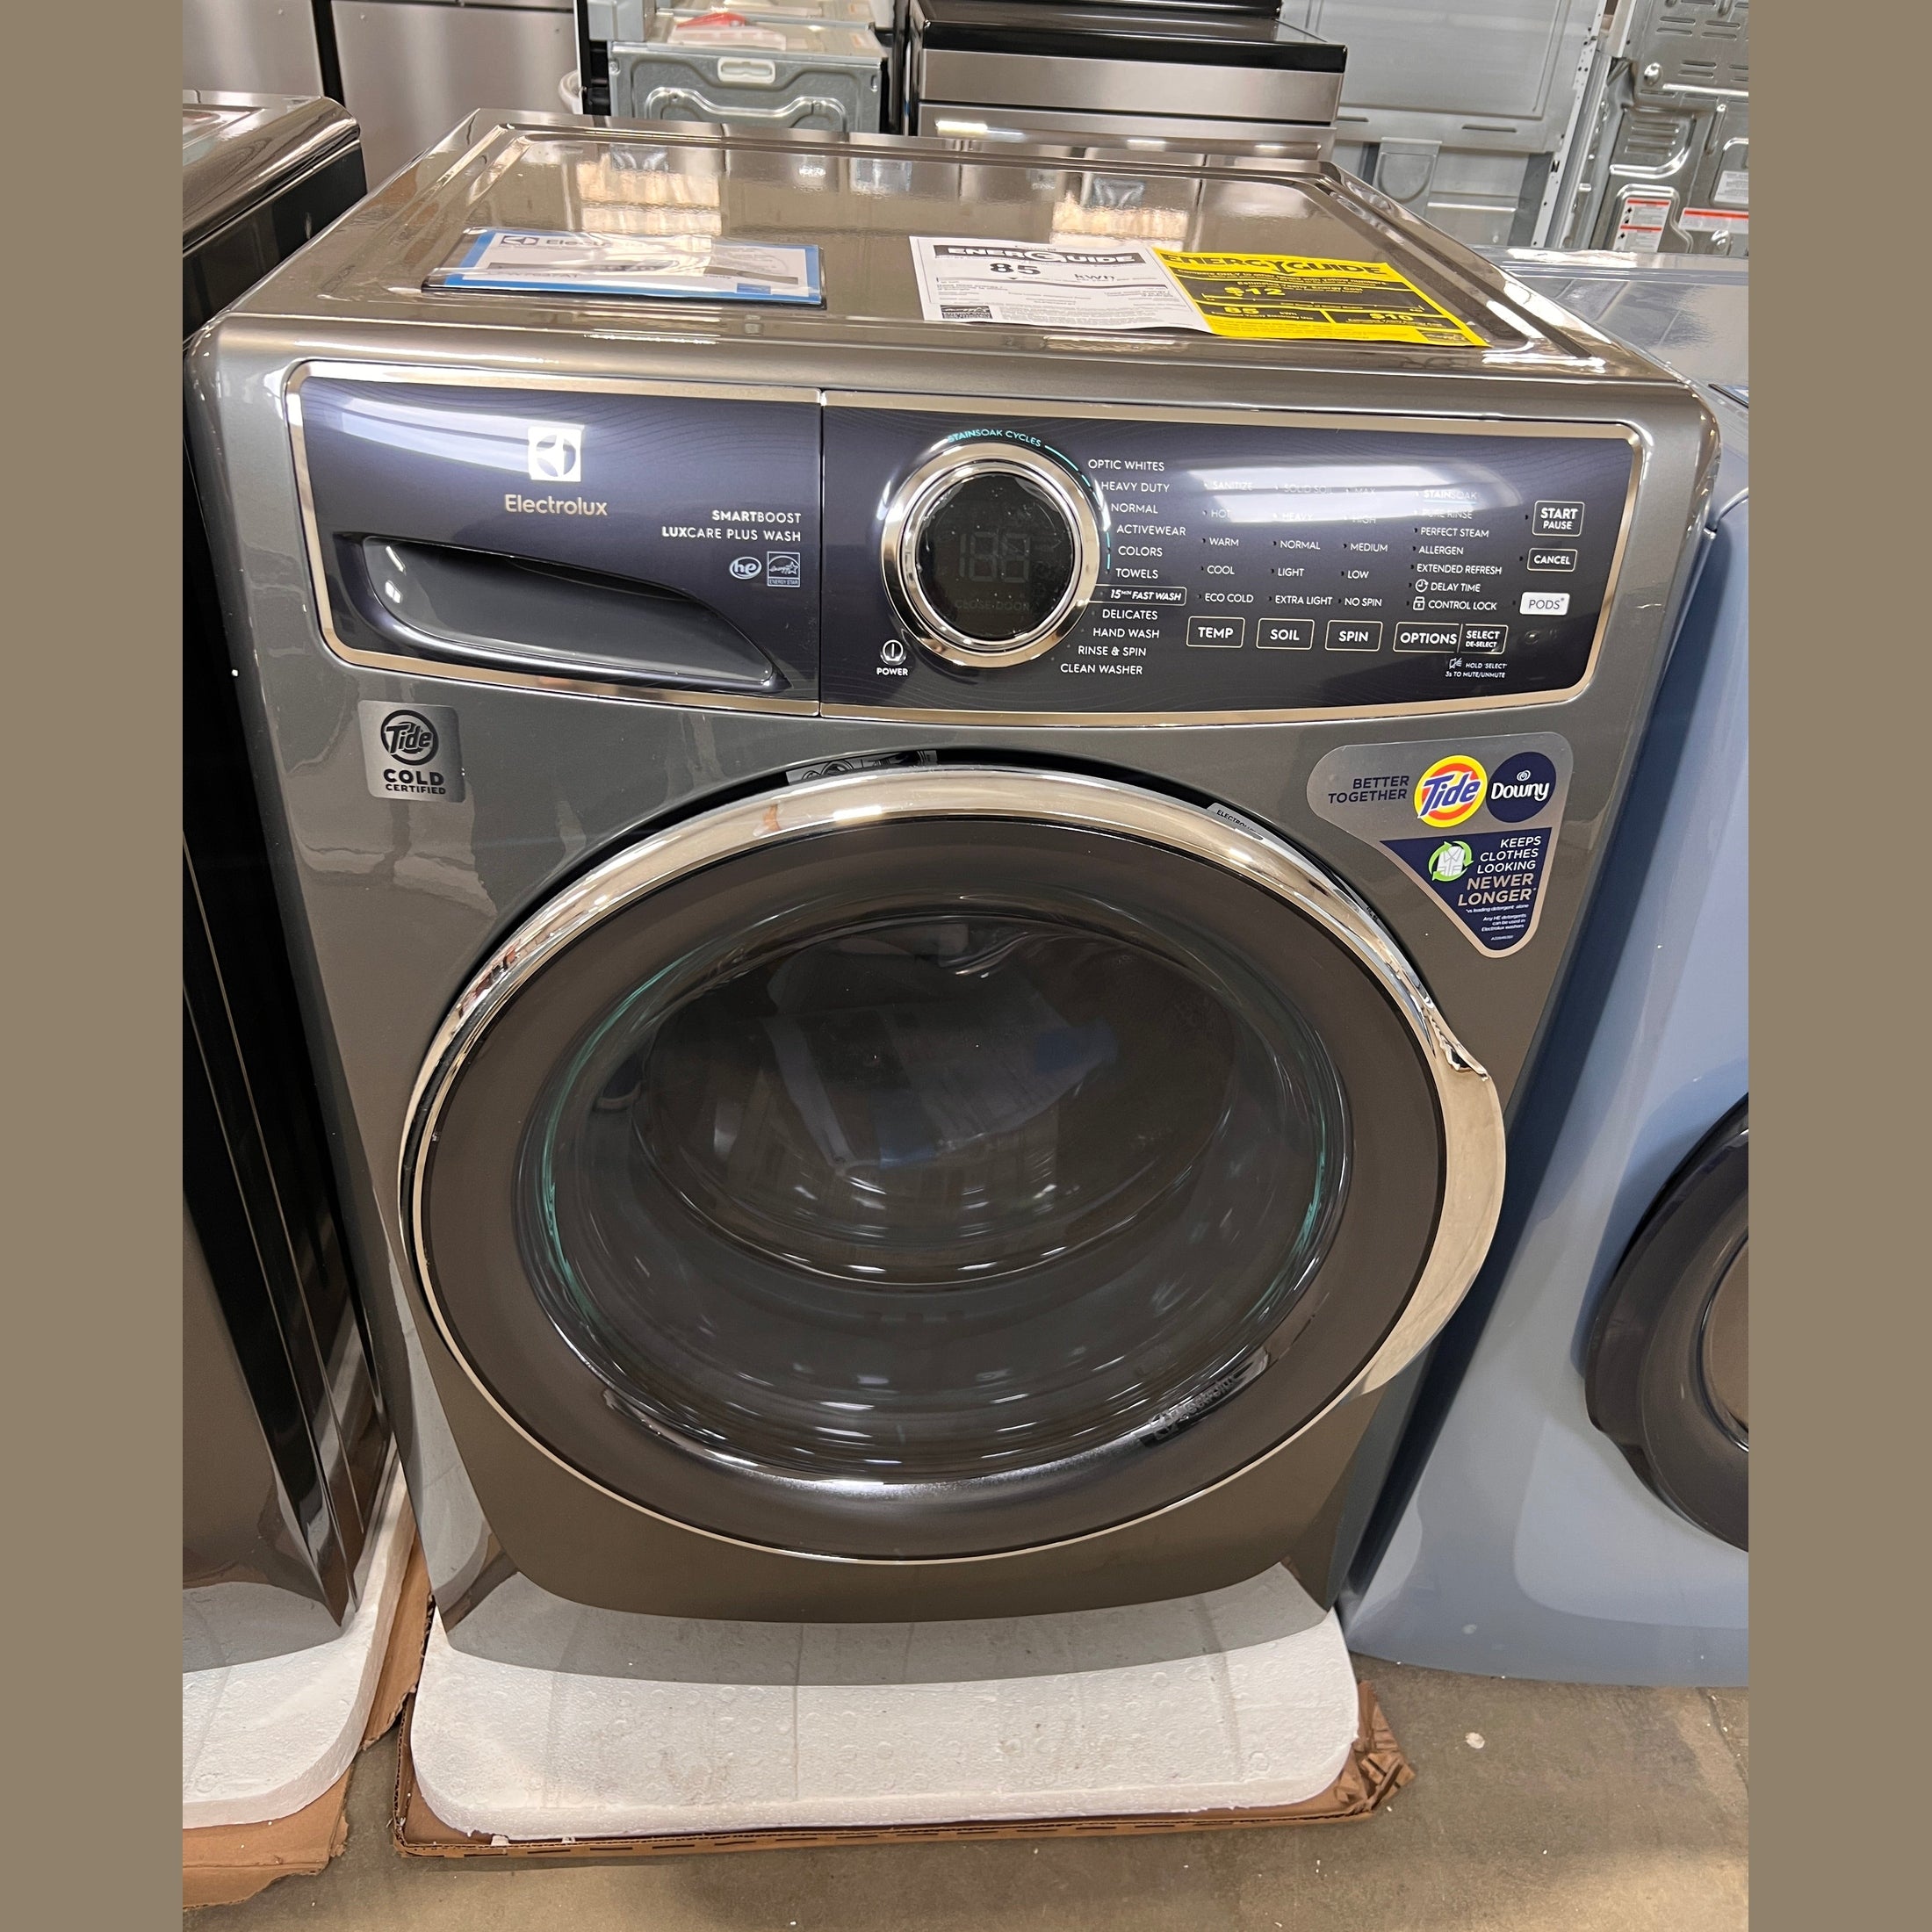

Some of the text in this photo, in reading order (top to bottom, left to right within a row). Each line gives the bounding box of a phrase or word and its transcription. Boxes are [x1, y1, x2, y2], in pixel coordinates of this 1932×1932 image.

[948, 247, 1135, 264] ENERGUIDE
[989, 263, 1042, 276] 85
[1160, 253, 1388, 276] ENERGYGUIDE
[1225, 286, 1286, 297] $12
[948, 429, 1042, 447] STAINSOAK CYCLES
[1088, 458, 1164, 472] OPTIC WHITES
[1101, 481, 1170, 493] HEAVY DUTY
[1424, 489, 1477, 500] STAINSOAK
[504, 494, 608, 515] Electrolux
[1111, 503, 1158, 515] NORMAL
[711, 509, 802, 523] SMARTBOOST
[1211, 508, 1231, 518] HOT
[1282, 512, 1314, 522] HEAVY
[1539, 507, 1579, 520] START
[1116, 524, 1186, 537] ACTIVEWEAR
[1543, 520, 1573, 530] PAUSE
[661, 526, 802, 543] LUXCARE PLUS WASH
[1420, 527, 1490, 537] PERFECT STEAM
[1208, 537, 1239, 546] WARM
[1280, 540, 1321, 550] NORMAL
[1350, 543, 1388, 552] MEDIUM
[1118, 545, 1163, 558] COLORS
[1418, 545, 1464, 555] ALLERGEN
[1533, 555, 1571, 566] CANCEL
[1115, 568, 1159, 580] TOWELS
[1207, 566, 1236, 575] COOL
[1277, 567, 1305, 577] LIGHT
[1347, 570, 1369, 580] LOW
[1417, 564, 1503, 575] EXTENDED REFRESH
[1431, 582, 1481, 593] DELAY TIME
[1132, 591, 1154, 601] FAST
[1155, 592, 1182, 602] WASH
[1205, 593, 1254, 603] ECO COLD
[1275, 595, 1333, 606] EXTRA LIGHT
[1344, 597, 1382, 608] NO SPIN
[1428, 601, 1497, 611] CONTROL LOCK
[1102, 609, 1158, 620] DELICATES
[1092, 628, 1160, 638] HAND WASH
[1198, 626, 1234, 639] TEMP
[1270, 629, 1301, 641] SOIL
[1338, 631, 1369, 643] SPIN
[1400, 631, 1458, 645] OPTIONS
[1466, 630, 1501, 640] SELECT
[1078, 645, 1147, 657] RINSE & SPIN
[876, 667, 909, 677] POWER
[1060, 663, 1143, 674] CLEAN WASHER
[385, 724, 433, 754] Tide
[383, 768, 444, 786] COLD
[1352, 775, 1409, 789] BETTER
[386, 783, 447, 795] CERTIFIED
[1417, 771, 1481, 819] Tide
[1490, 782, 1551, 802] Downy
[1328, 789, 1408, 804] TOGETHER
[1500, 835, 1541, 848] KEEPS
[1480, 848, 1539, 862] CLOTHES
[1476, 861, 1536, 875] LOOKING
[1467, 873, 1534, 890] NEWER
